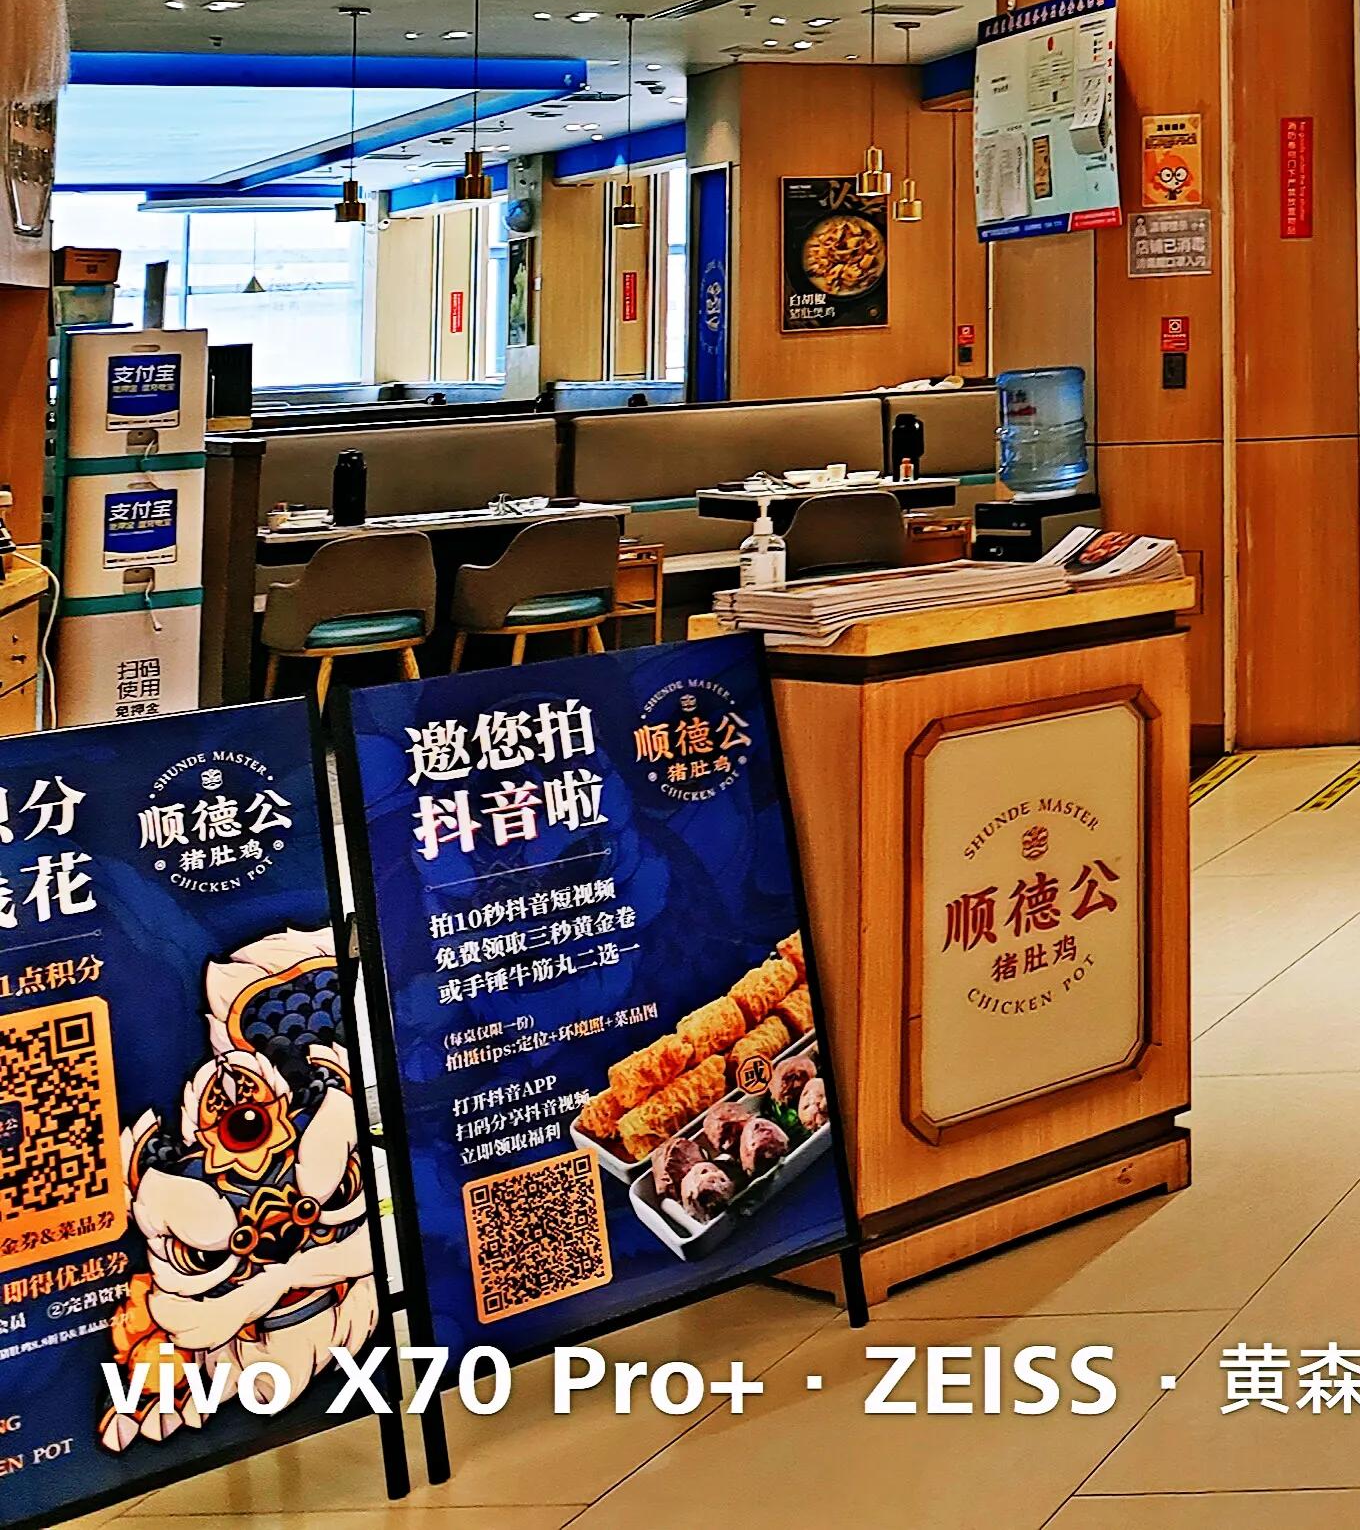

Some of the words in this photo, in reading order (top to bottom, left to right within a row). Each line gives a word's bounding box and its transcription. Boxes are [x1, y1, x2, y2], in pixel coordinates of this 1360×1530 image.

[112, 364, 176, 383] 支付宝
[108, 500, 173, 521] 支付宝
[117, 658, 160, 680] 扫码
[117, 679, 160, 699] 使用
[688, 679, 730, 700] MASTER
[115, 703, 160, 717] 免押金
[404, 698, 596, 786] 邀您拍
[633, 712, 752, 762] 顺德公
[154, 753, 206, 792] SHUNDE
[213, 751, 267, 777] MASTER
[667, 755, 732, 782] 猪肚鸡
[661, 783, 716, 801] CHICKEN
[139, 789, 292, 849] 顺德公
[412, 769, 608, 860] 抖音啦
[965, 801, 1031, 860] SHUNDE
[1038, 798, 1101, 831] MASTER
[171, 874, 241, 893] CHICKEN
[248, 857, 273, 881] POT
[179, 839, 263, 872] 猪肚鸡
[429, 877, 616, 938] 拍10秒抖音短视频
[942, 859, 1120, 952] 顺德公
[435, 906, 636, 973] 免费领取三秒黄金卷
[991, 935, 1077, 982] 猪肚鸡
[438, 942, 640, 1004] 或手锤牛筋丸二选一
[967, 987, 1052, 1014] CHICKEN
[1063, 954, 1095, 992] POT
[744, 1060, 768, 1088] 或
[453, 1075, 557, 1117] 打开抖音APP
[455, 1089, 590, 1142] 扫码分享抖音视频
[460, 1122, 560, 1166] 立即领取福利
[4, 1252, 128, 1304] 即得优惠券
[32, 1438, 73, 1464] POT
